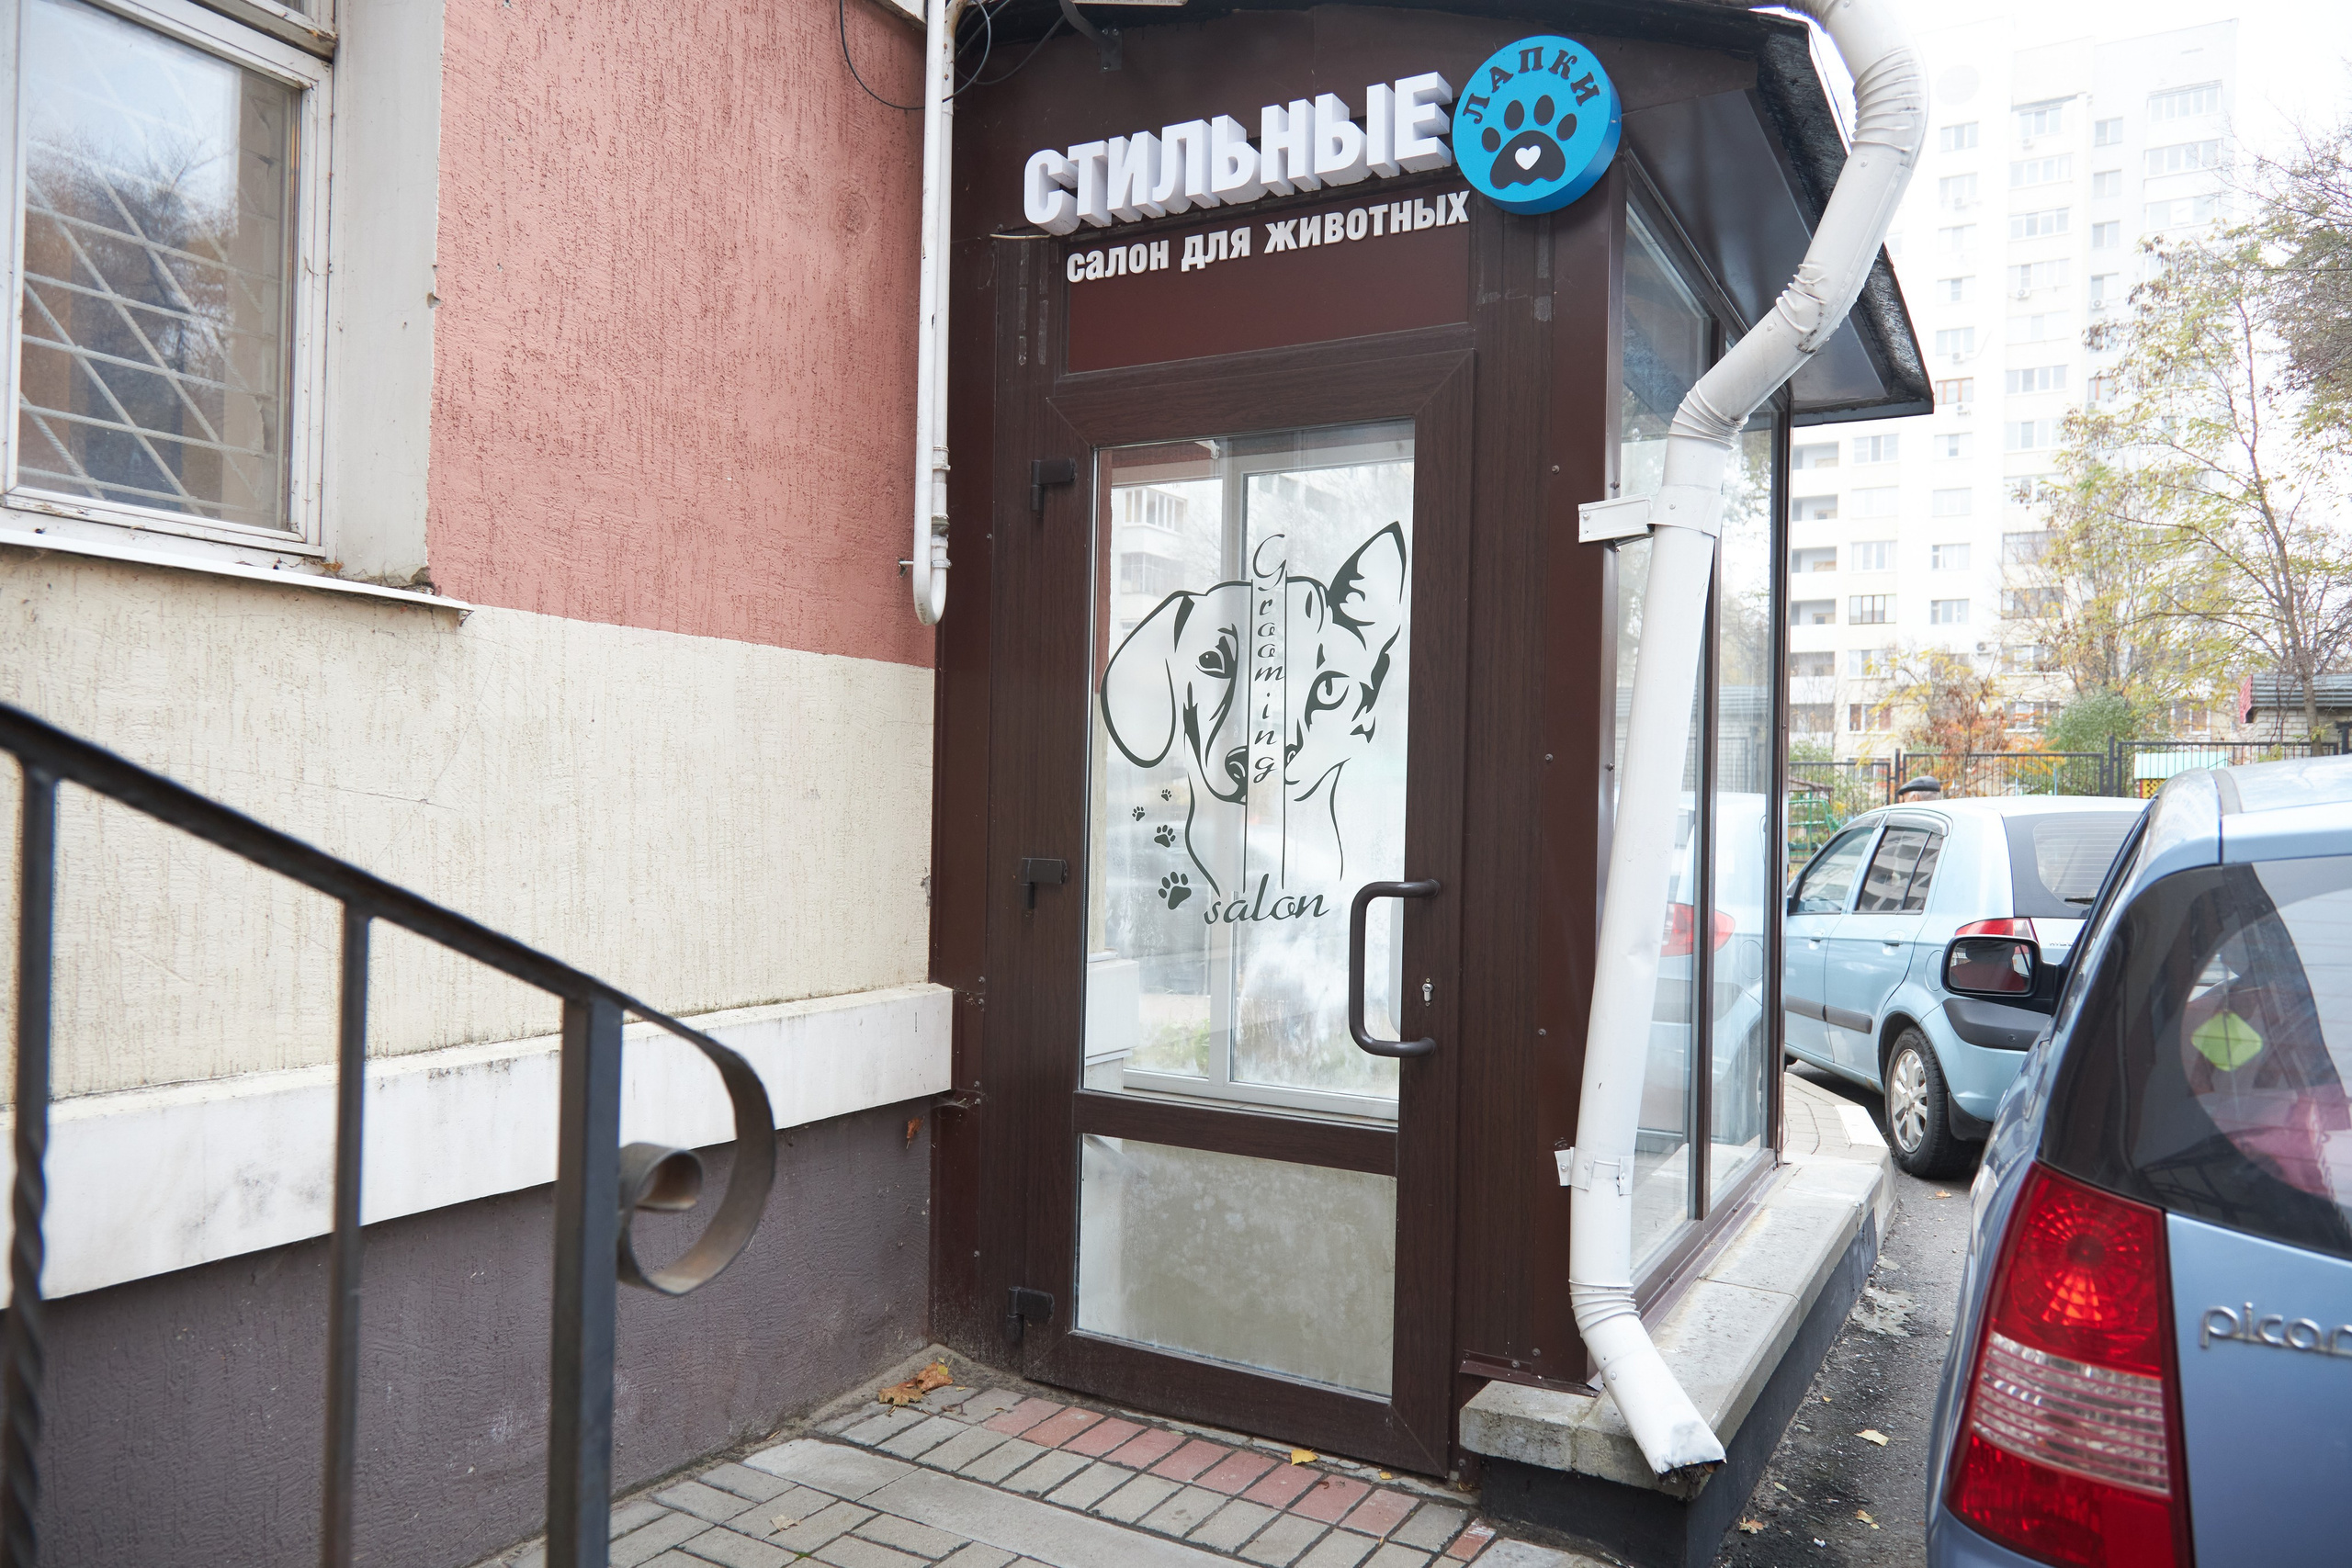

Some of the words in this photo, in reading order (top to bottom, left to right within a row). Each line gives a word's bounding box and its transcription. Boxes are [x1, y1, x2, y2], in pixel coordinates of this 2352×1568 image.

[1462, 46, 1600, 124] ЛАПКИ
[1023, 71, 1453, 235] СТИЛЬНЫЕ
[1066, 239, 1170, 284] салон
[1181, 226, 1252, 273] для
[1263, 189, 1470, 254] животных
[1204, 873, 1330, 925] salon
